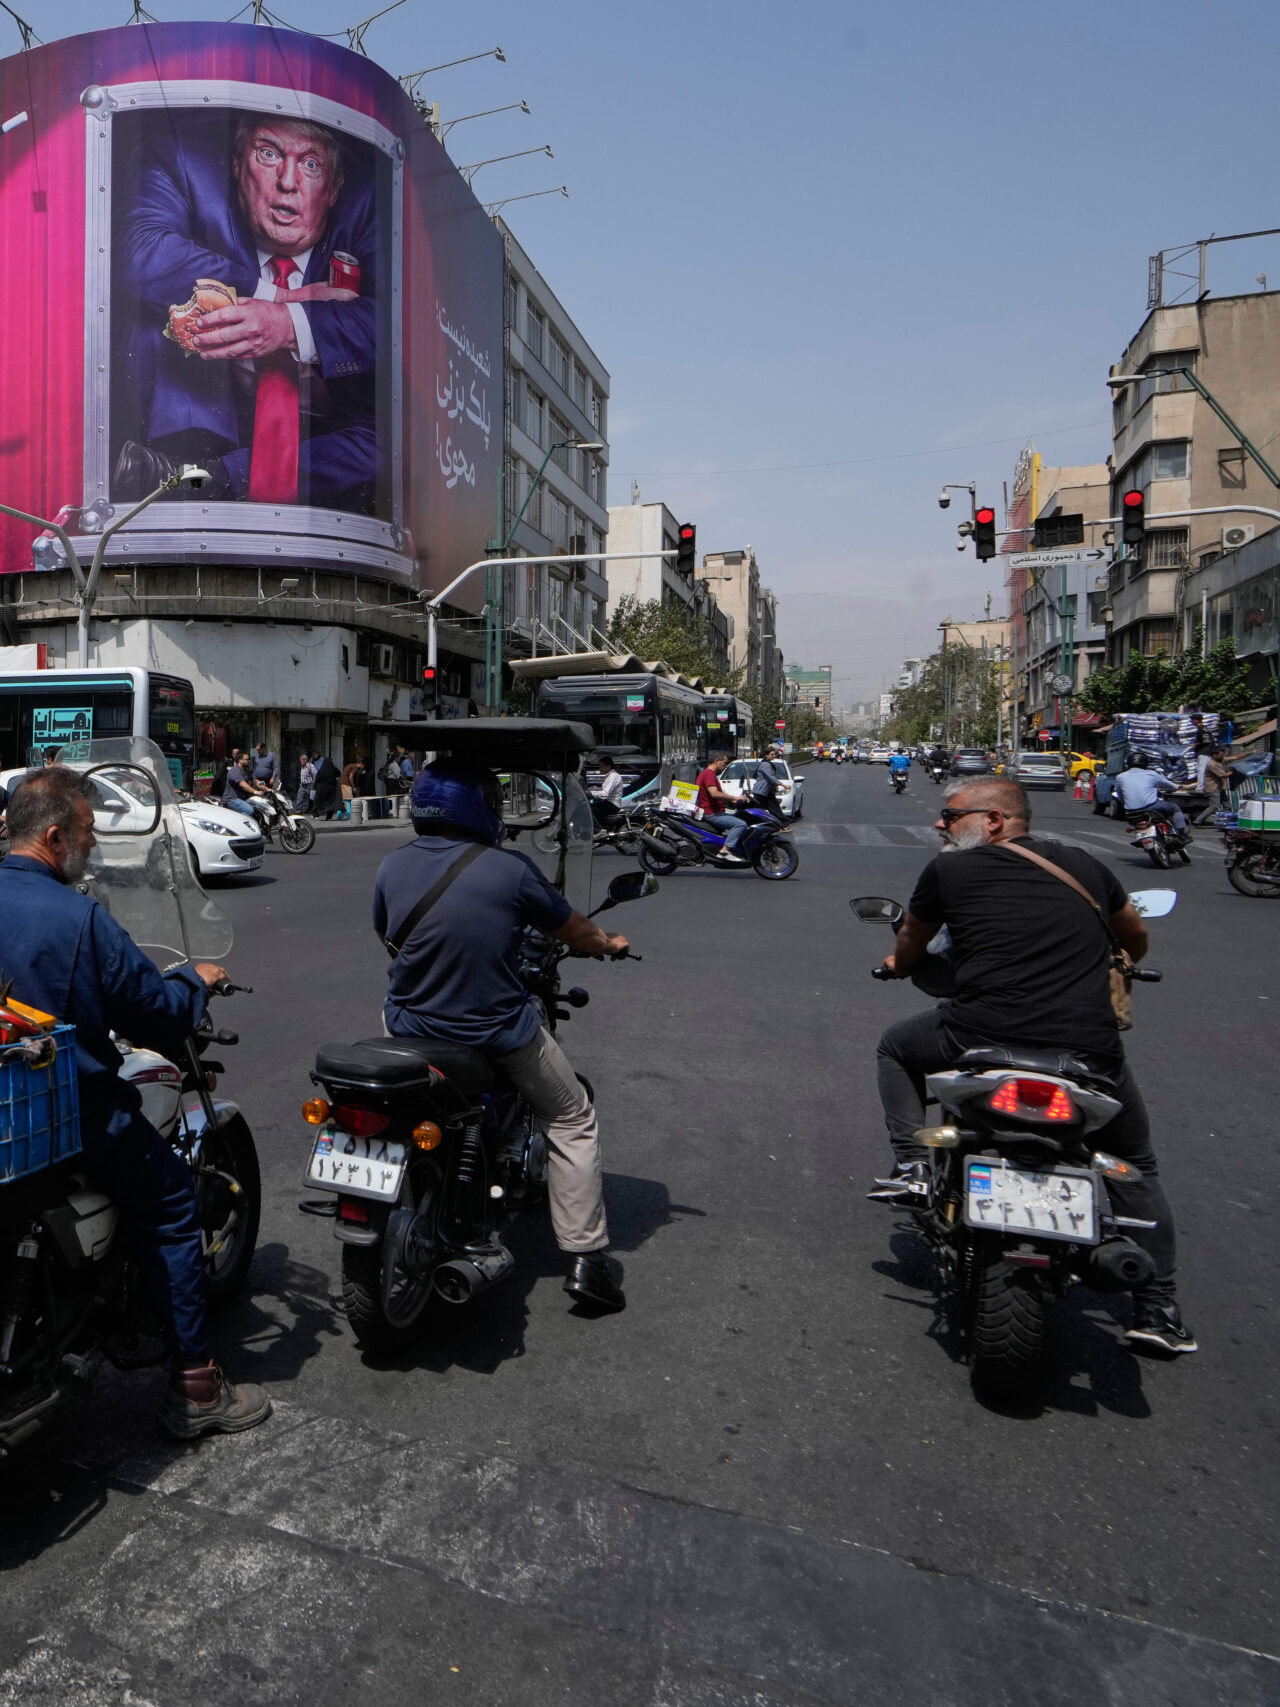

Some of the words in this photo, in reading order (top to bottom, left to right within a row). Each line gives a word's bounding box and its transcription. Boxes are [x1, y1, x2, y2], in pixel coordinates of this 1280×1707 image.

[466, 374, 491, 452] پلک
[1012, 555, 1041, 564] اسلامی
[1042, 554, 1074, 562] جمهوری
[970, 1186, 991, 1194] IRAN
